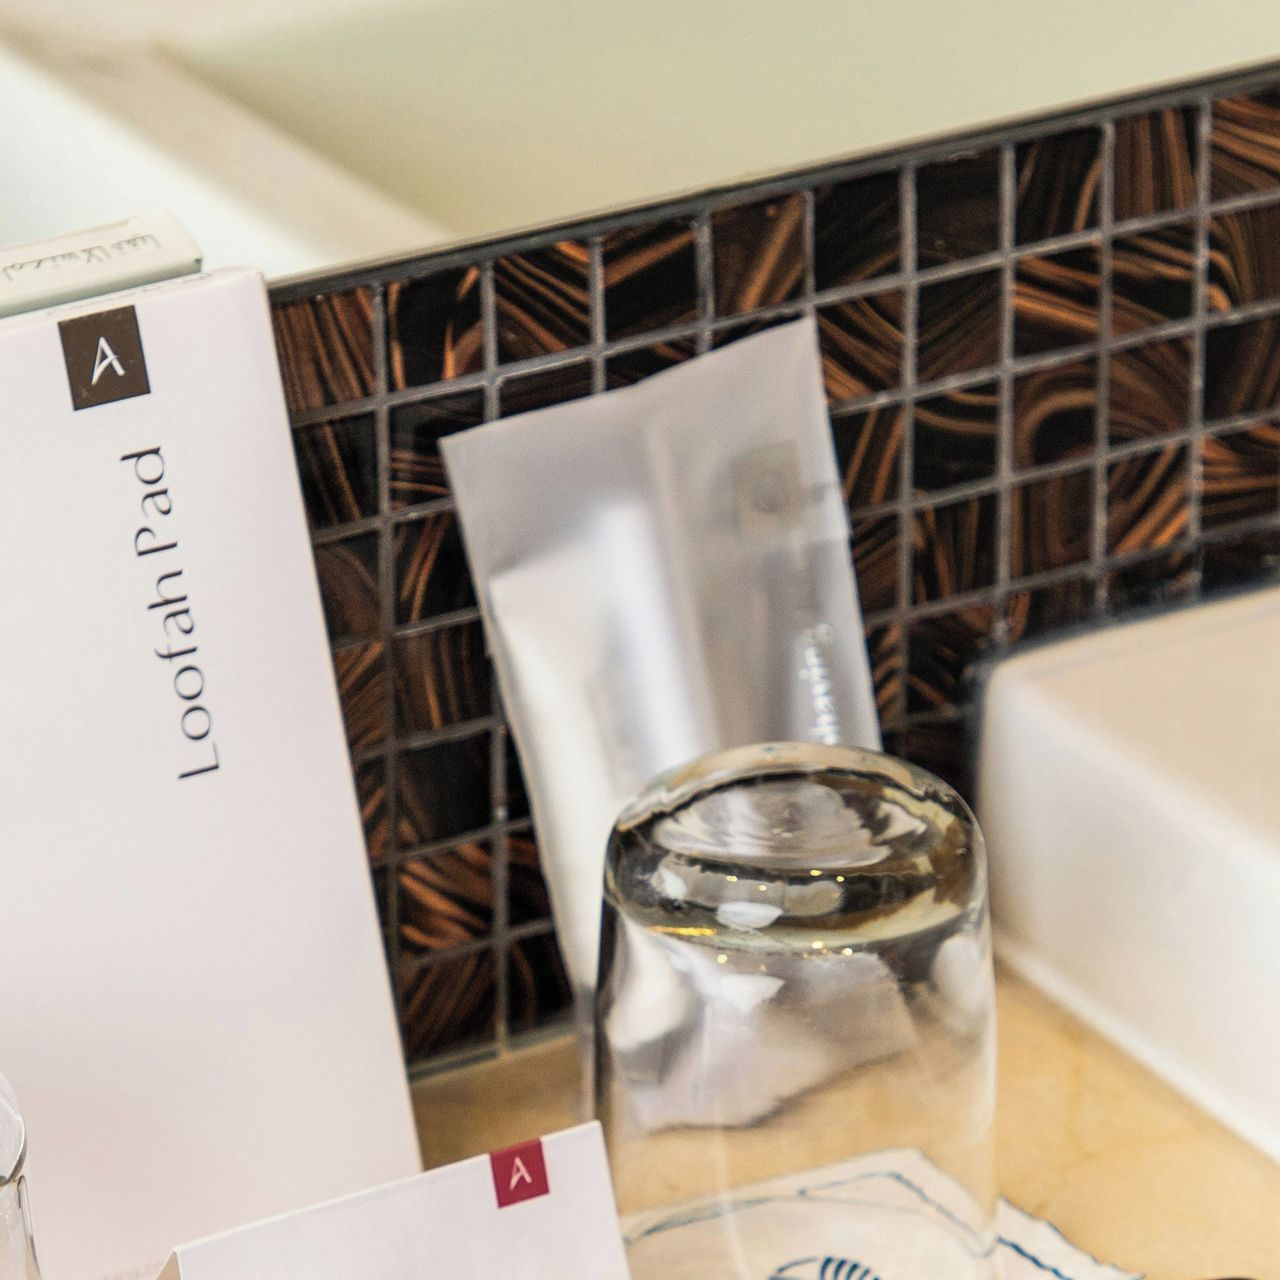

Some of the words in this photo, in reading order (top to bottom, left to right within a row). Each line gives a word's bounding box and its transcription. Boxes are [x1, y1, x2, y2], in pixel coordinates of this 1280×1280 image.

[91, 335, 125, 385] A
[120, 445, 179, 557] Pad
[147, 568, 220, 780] Loofah
[509, 1156, 533, 1191] A
